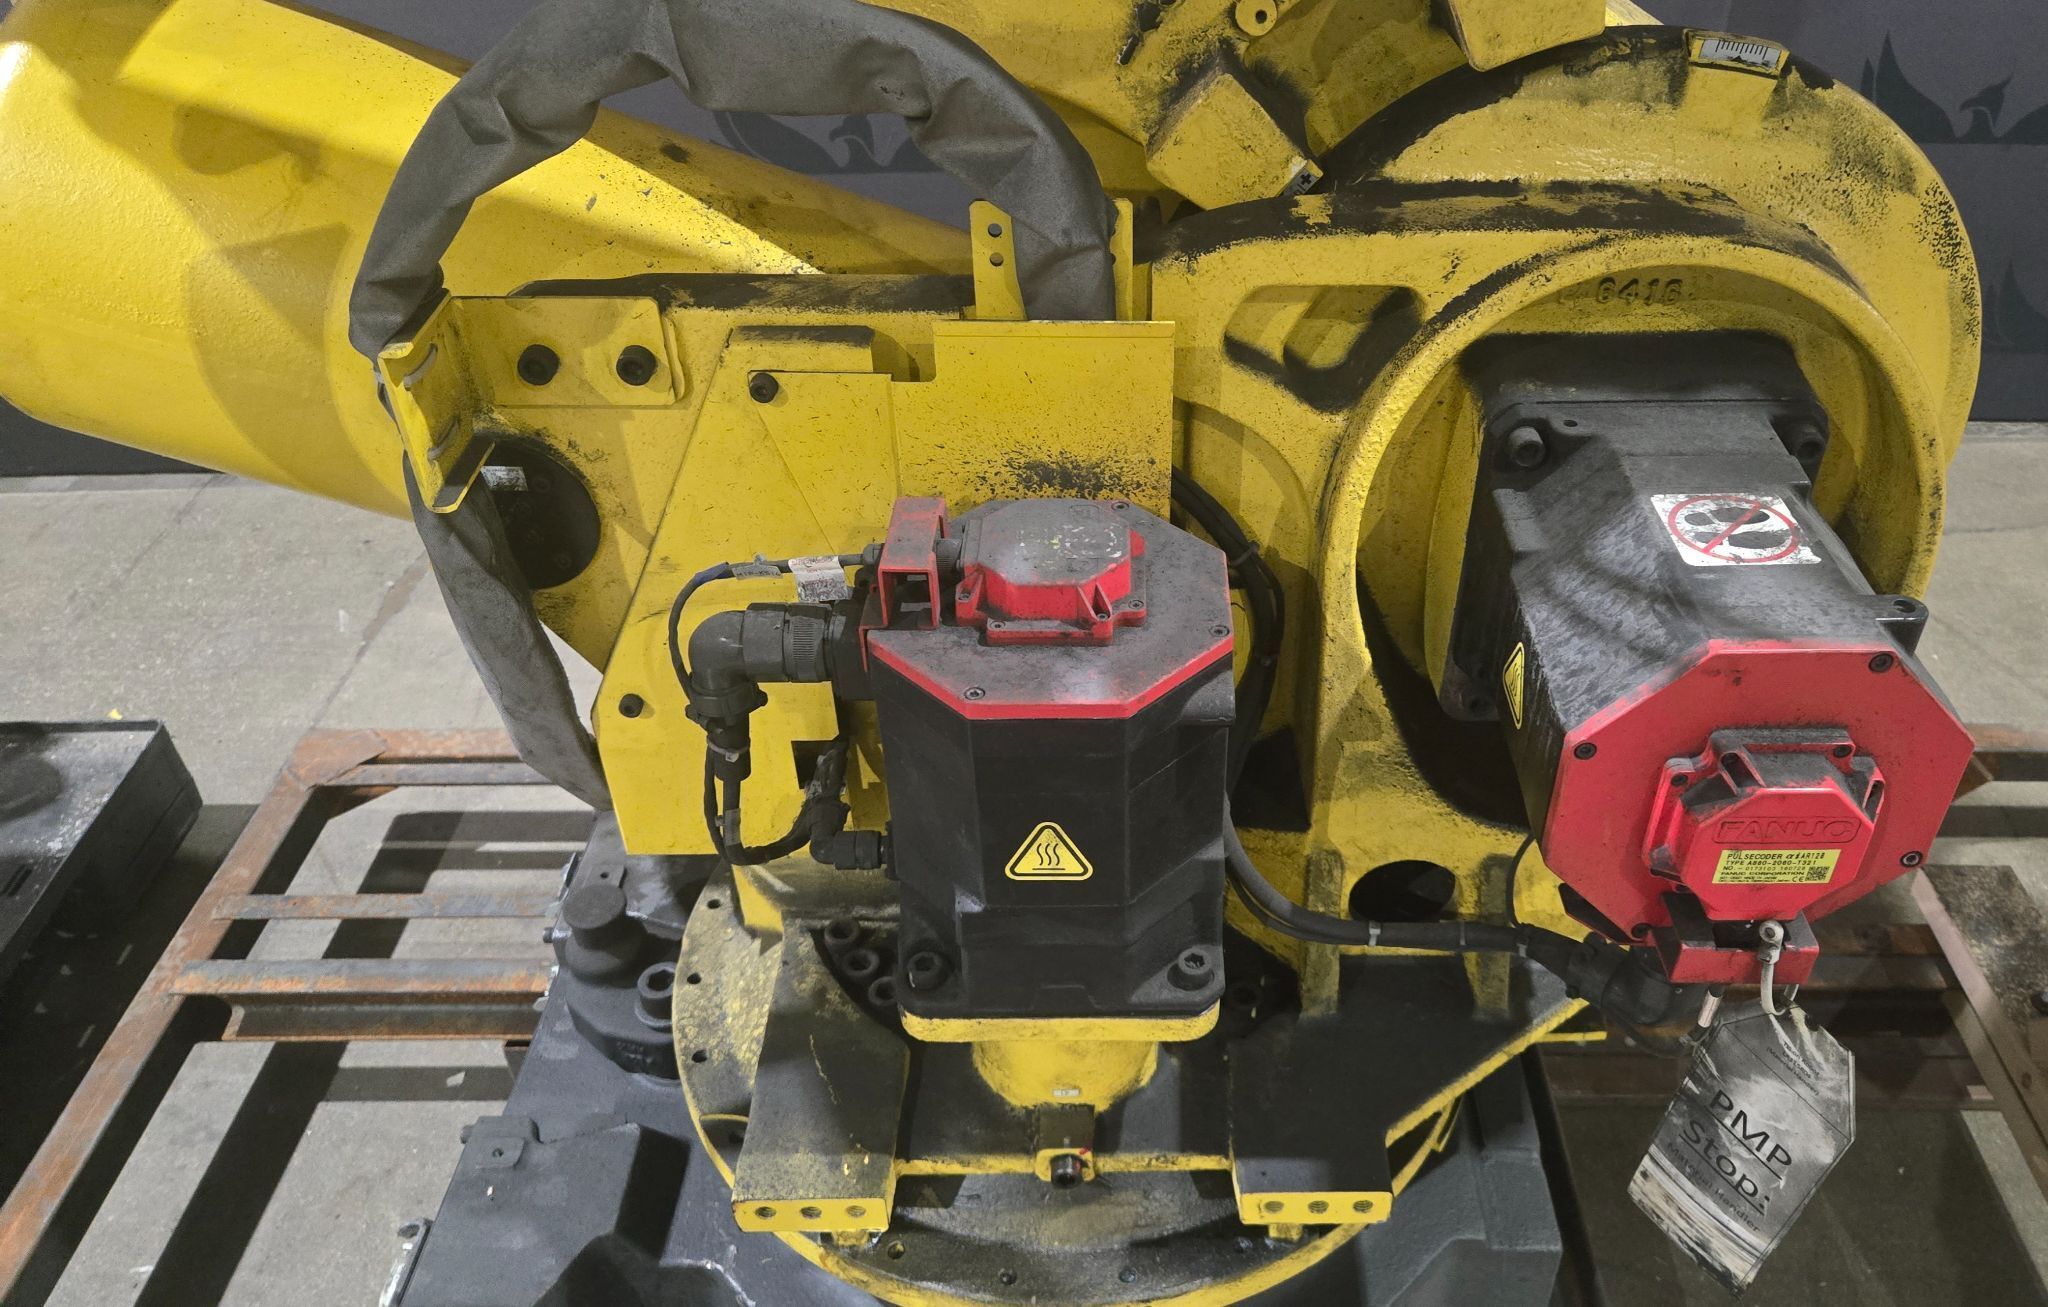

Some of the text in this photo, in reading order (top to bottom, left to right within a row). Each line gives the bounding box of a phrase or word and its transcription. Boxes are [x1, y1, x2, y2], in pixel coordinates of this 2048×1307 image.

[1717, 820, 1854, 840] FANUC
[1709, 1089, 1793, 1167] PMP
[1683, 1118, 1771, 1210] Stop:
[1715, 1187, 1760, 1232] Handler
